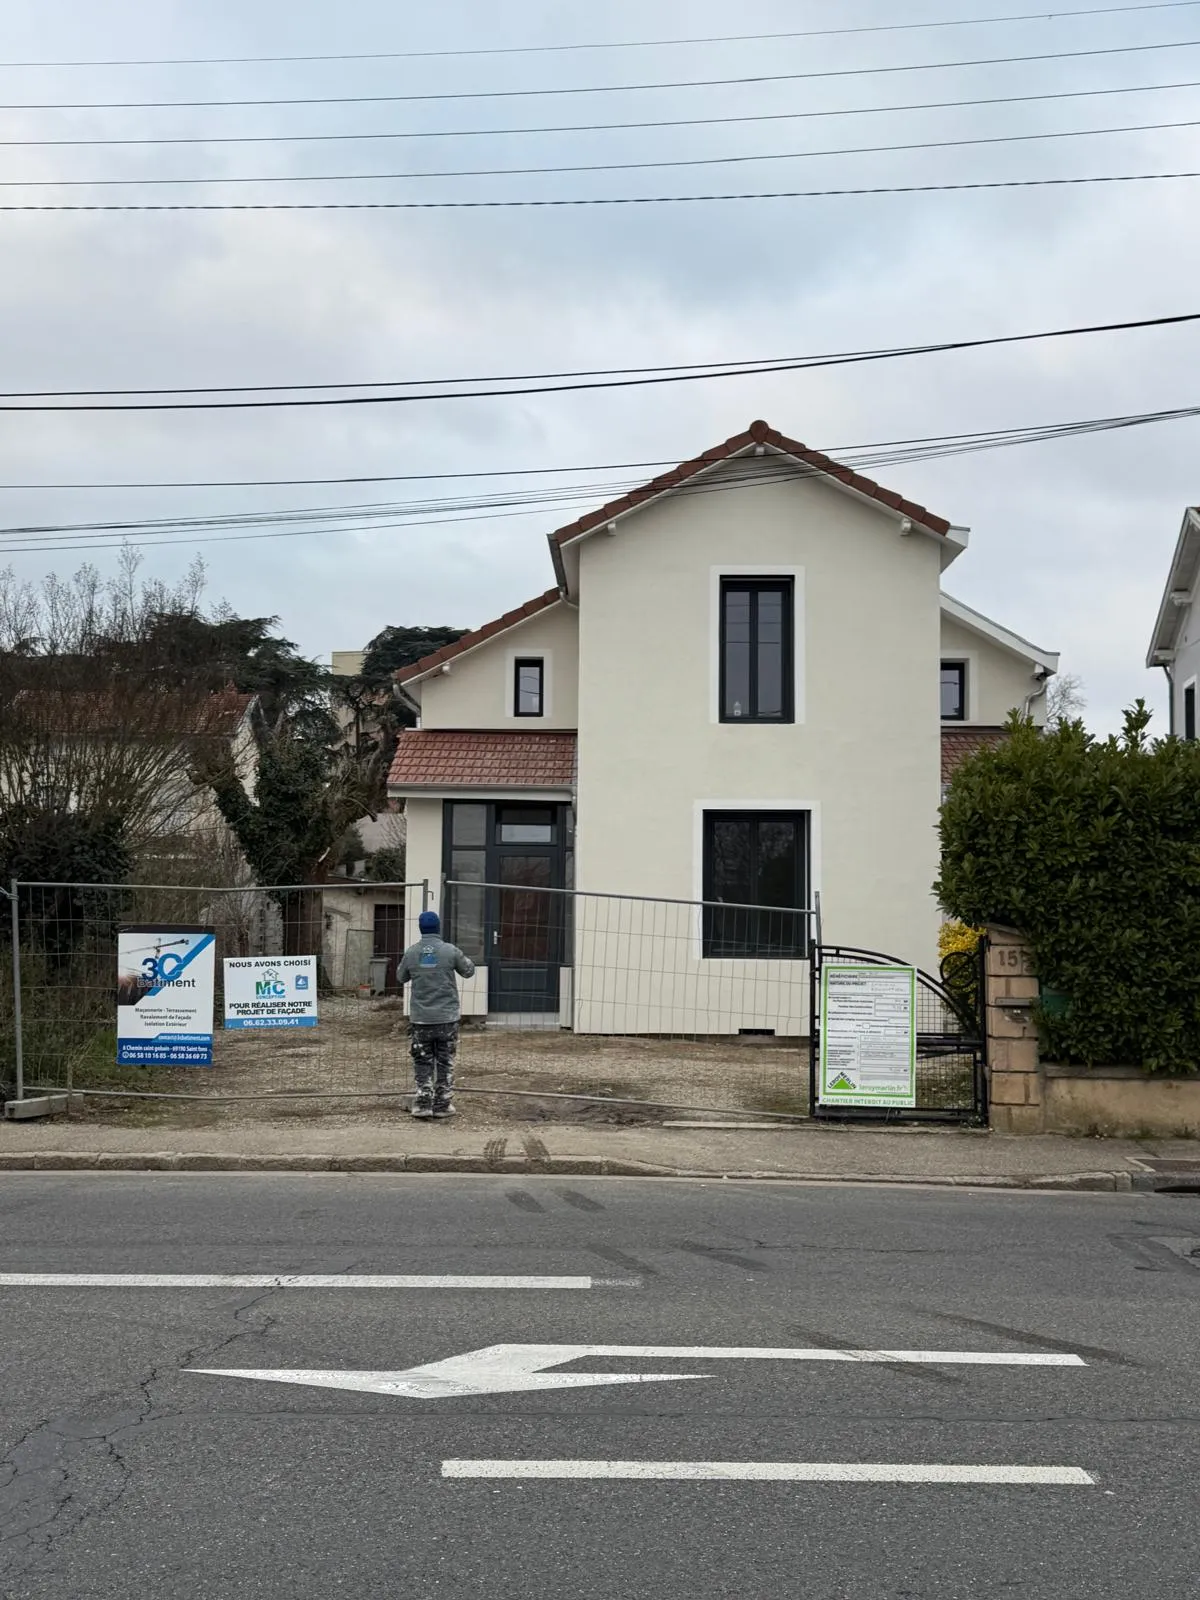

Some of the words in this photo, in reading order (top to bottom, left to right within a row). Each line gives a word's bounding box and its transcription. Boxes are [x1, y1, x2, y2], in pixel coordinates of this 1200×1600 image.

[142, 953, 183, 980] 3C
[255, 960, 281, 968] AVONS
[283, 959, 311, 967] CHOISI
[256, 980, 286, 995] MC
[277, 1007, 306, 1016] FAÇADE
[175, 1014, 192, 1022] Façade
[827, 1075, 841, 1089] LEROY
[840, 1071, 857, 1089] MERLIN
